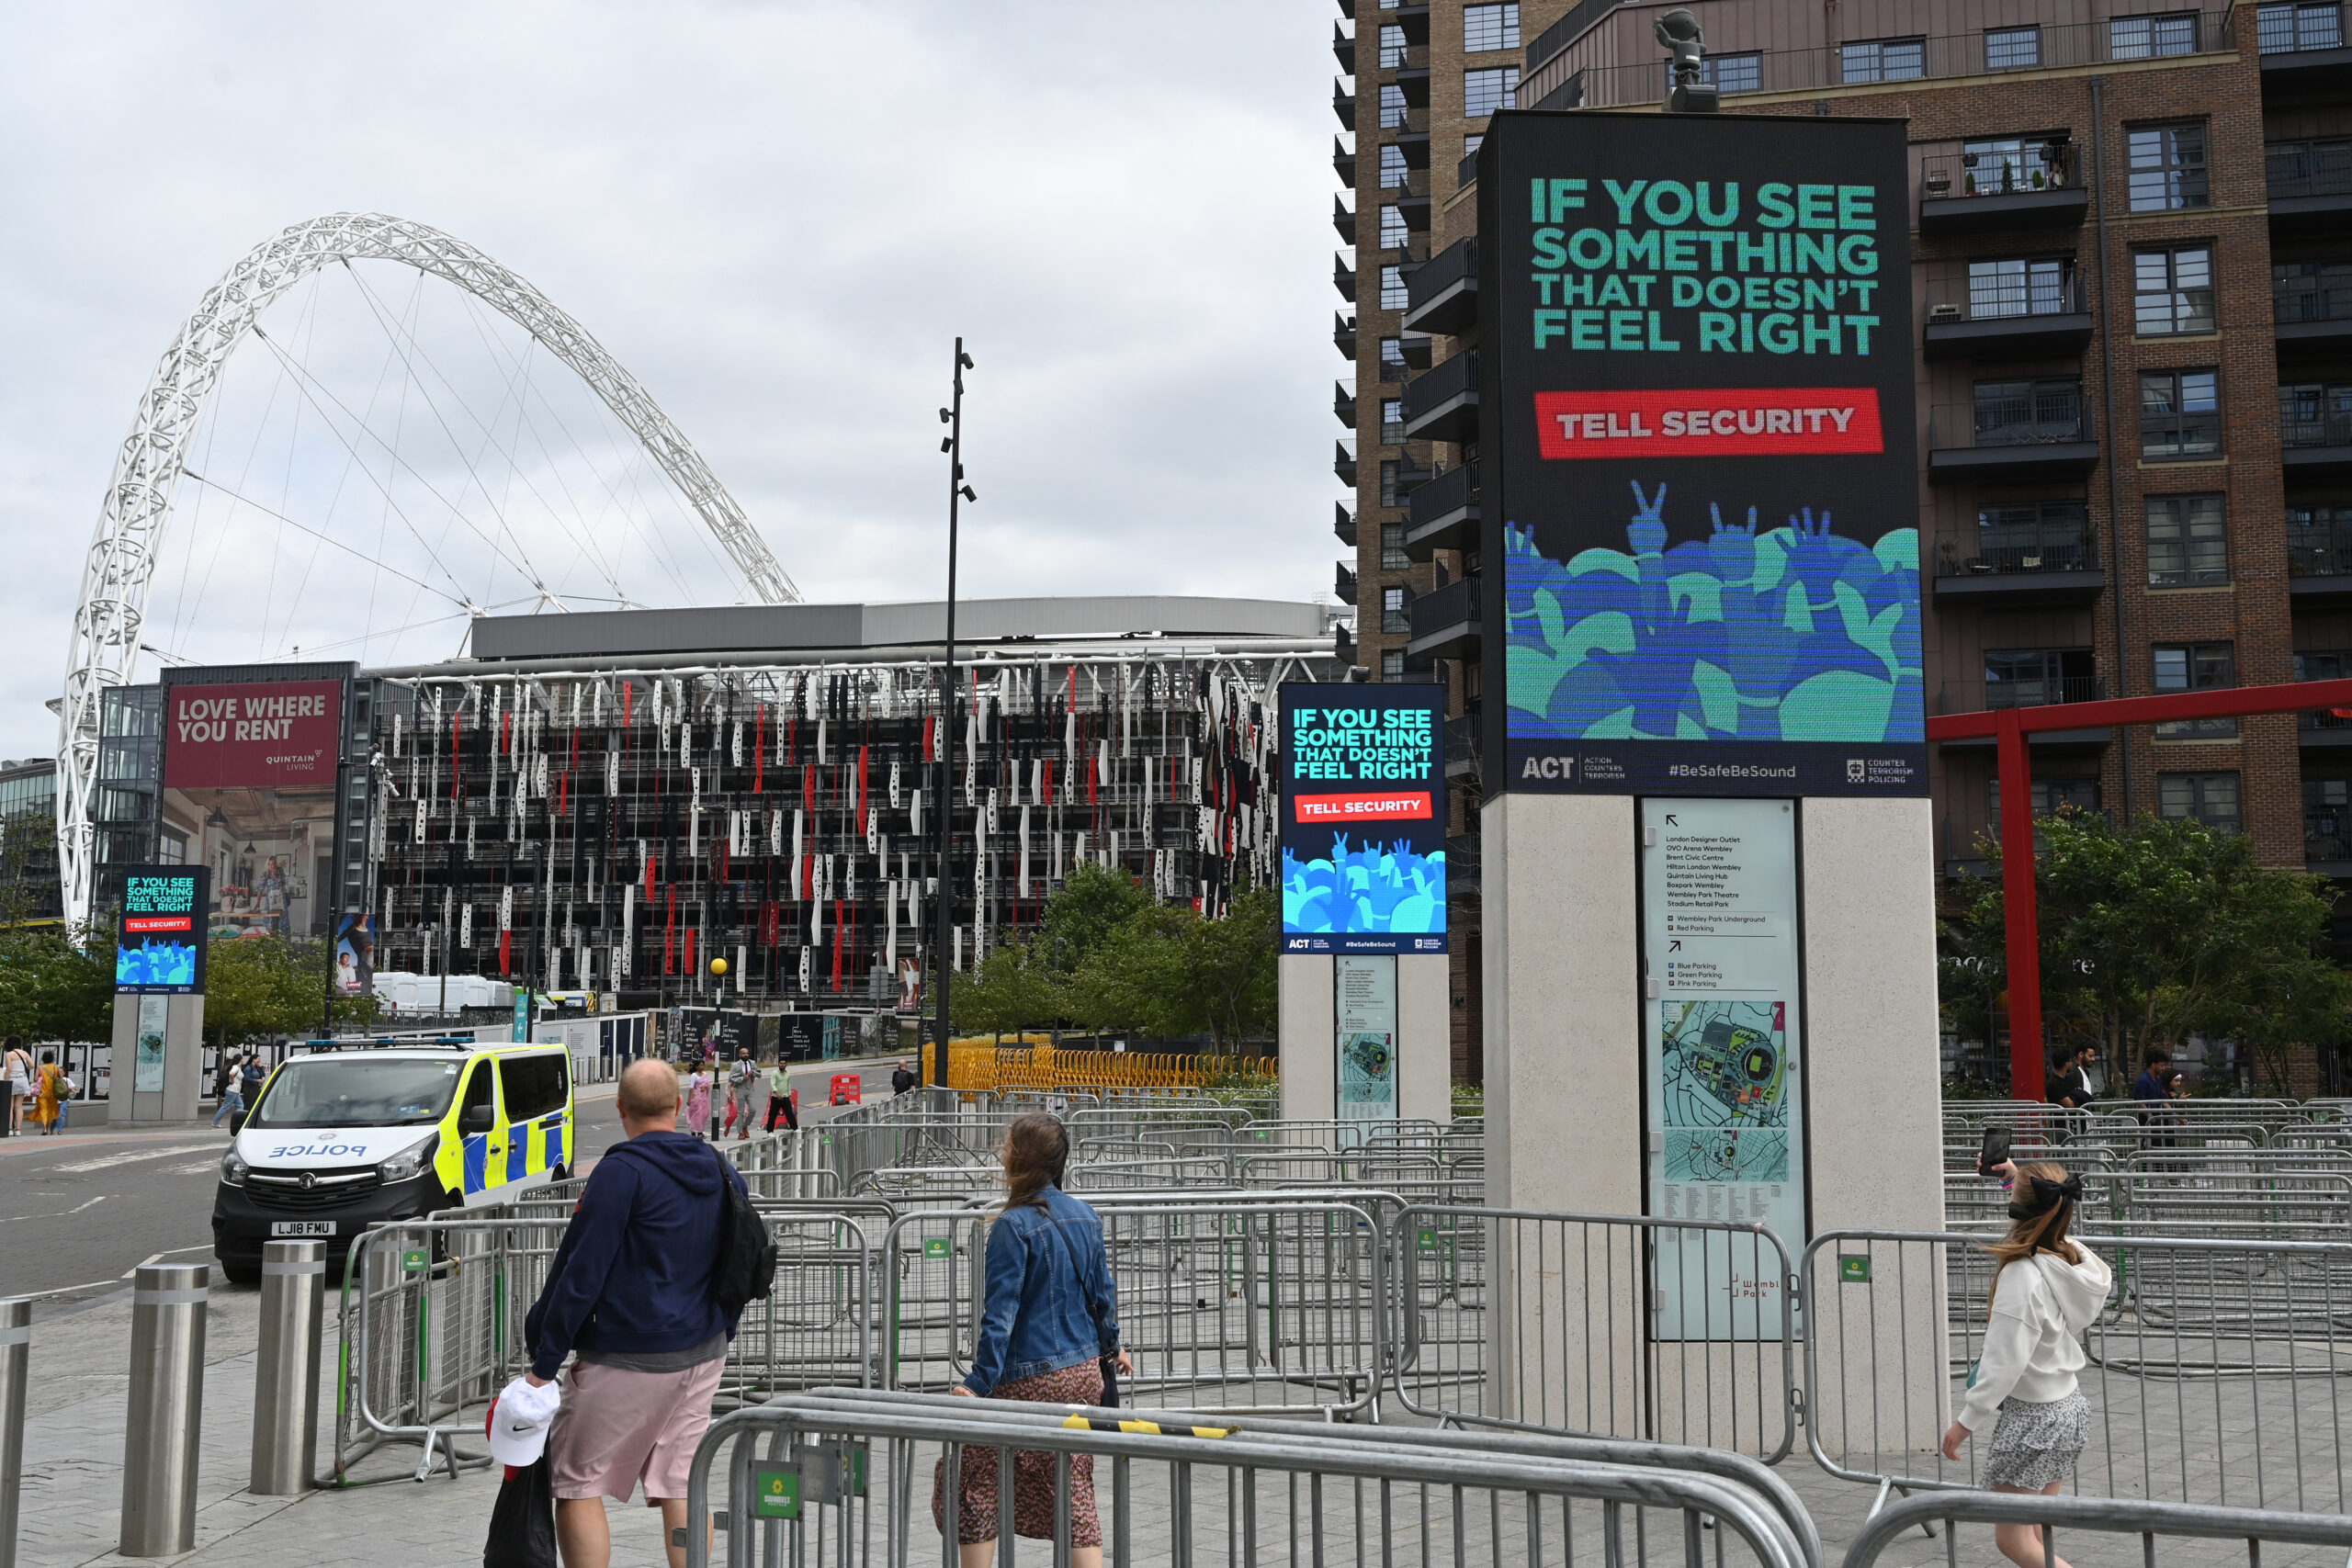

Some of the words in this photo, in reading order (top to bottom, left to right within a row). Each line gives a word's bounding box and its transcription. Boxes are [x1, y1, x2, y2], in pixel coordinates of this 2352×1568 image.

[1531, 178, 1588, 223] IF
[1601, 179, 1739, 227] YOU
[1757, 182, 1876, 231] SEE
[1531, 228, 1879, 275] SOMETHING
[1532, 274, 1657, 307] THAT
[1672, 276, 1879, 311] DOESN'T
[1533, 309, 1680, 351] FEEL
[1700, 311, 1880, 355] RIGHT
[1556, 412, 1652, 439] TELL
[1662, 407, 1855, 436] SECURITY
[178, 698, 237, 720] LOVE
[244, 694, 326, 718] WHERE
[1294, 709, 1317, 728] IF
[1322, 709, 1377, 728] YOU
[1383, 709, 1431, 728] SEE
[177, 720, 227, 742] YOU
[235, 718, 293, 741] RENT
[1294, 728, 1432, 747] SOMETHING
[266, 755, 315, 764] QUINTAIN
[1294, 747, 1343, 761] THAT
[1349, 748, 1431, 761] DOESN'T
[287, 762, 314, 771] LIVING
[1294, 761, 1352, 779] FEEL
[1360, 762, 1432, 780] RIGHT
[1521, 756, 1574, 779] ACT
[1668, 764, 1796, 777] #BeSafeBeSound
[1868, 767, 1914, 775] TERRORISM
[1303, 803, 1340, 815] TELL
[1344, 799, 1421, 813] SECURITY
[128, 877, 140, 887] IF
[141, 877, 168, 887] YOU
[170, 877, 195, 887] SEE
[127, 887, 194, 896] SOMETHING
[126, 903, 154, 912] FEEL
[157, 903, 193, 912] RIGHT
[1289, 939, 1309, 949] ACT
[278, 1224, 303, 1235] LJ18
[307, 1223, 329, 1234] FMU
